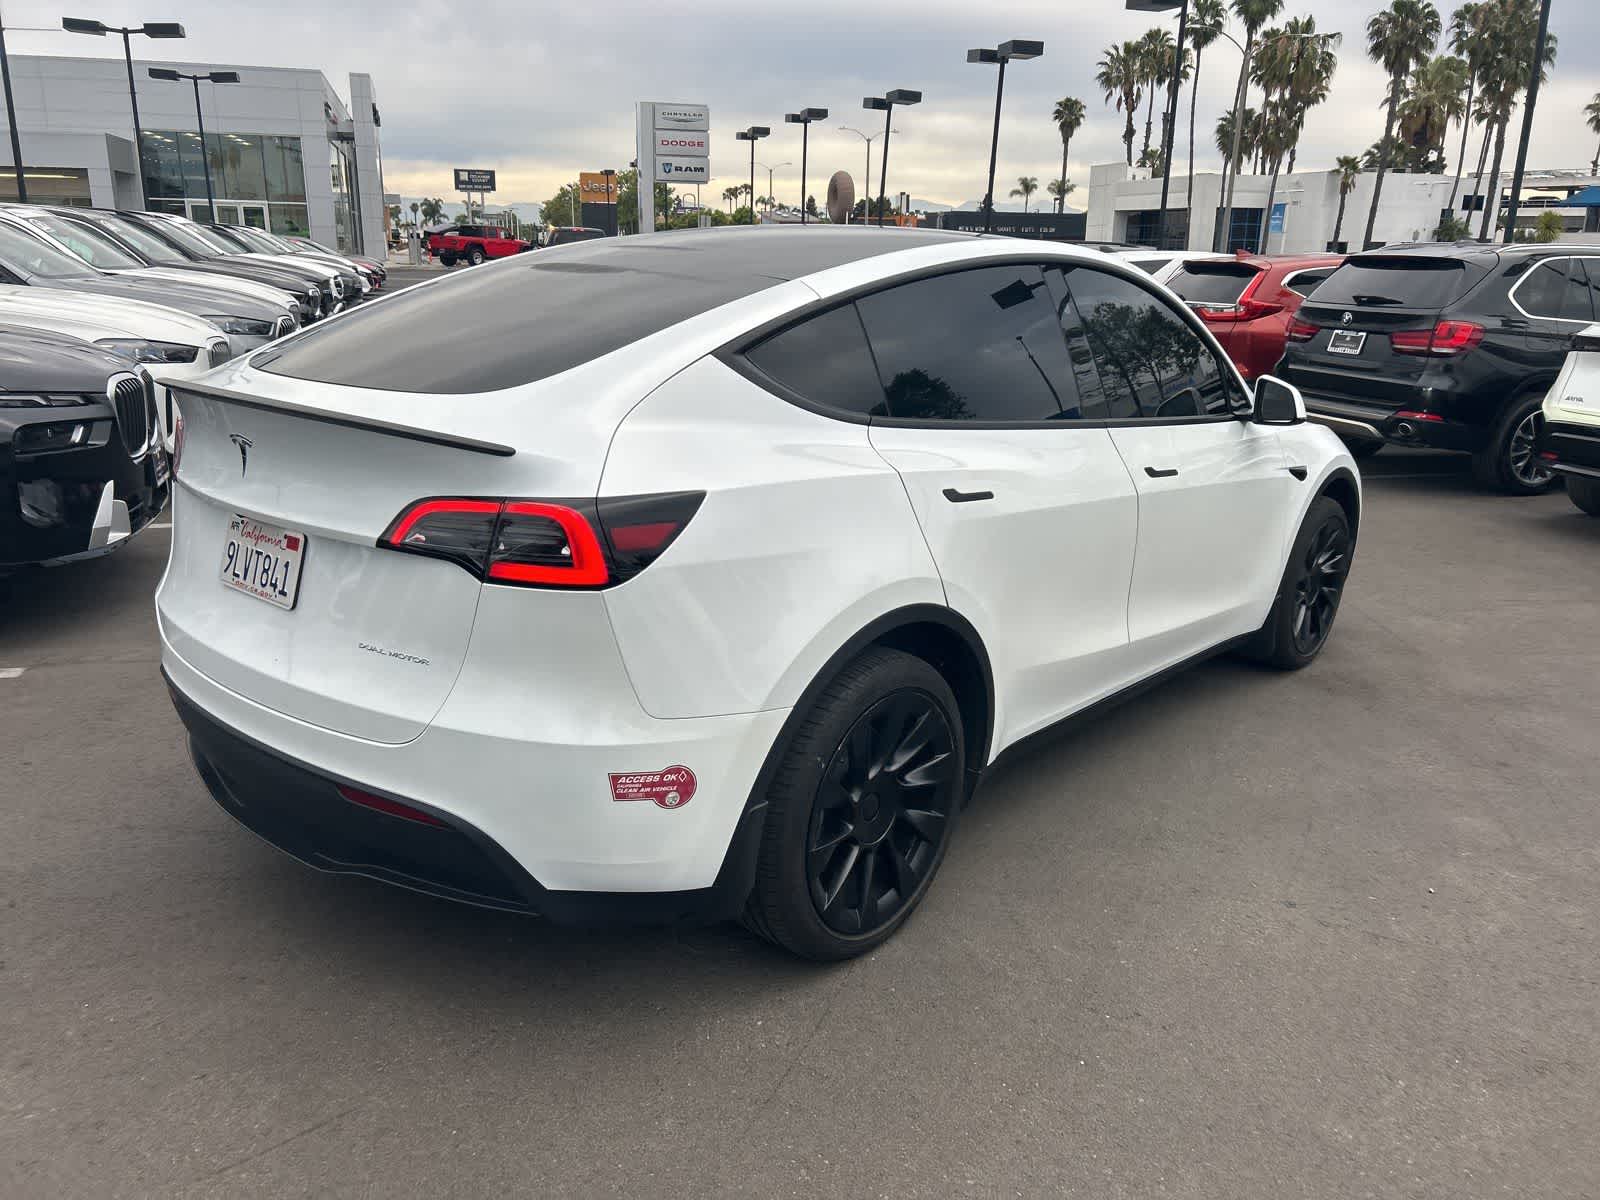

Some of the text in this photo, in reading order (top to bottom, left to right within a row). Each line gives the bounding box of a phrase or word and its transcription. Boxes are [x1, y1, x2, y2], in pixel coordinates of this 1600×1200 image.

[661, 139, 705, 148] DODGE
[674, 165, 705, 173] RAM
[583, 180, 615, 193] Jeep
[240, 521, 282, 547] California
[223, 541, 290, 597] 9LVT841
[359, 642, 430, 666] DUAL MOTOR
[617, 773, 679, 784] ACCESS OK
